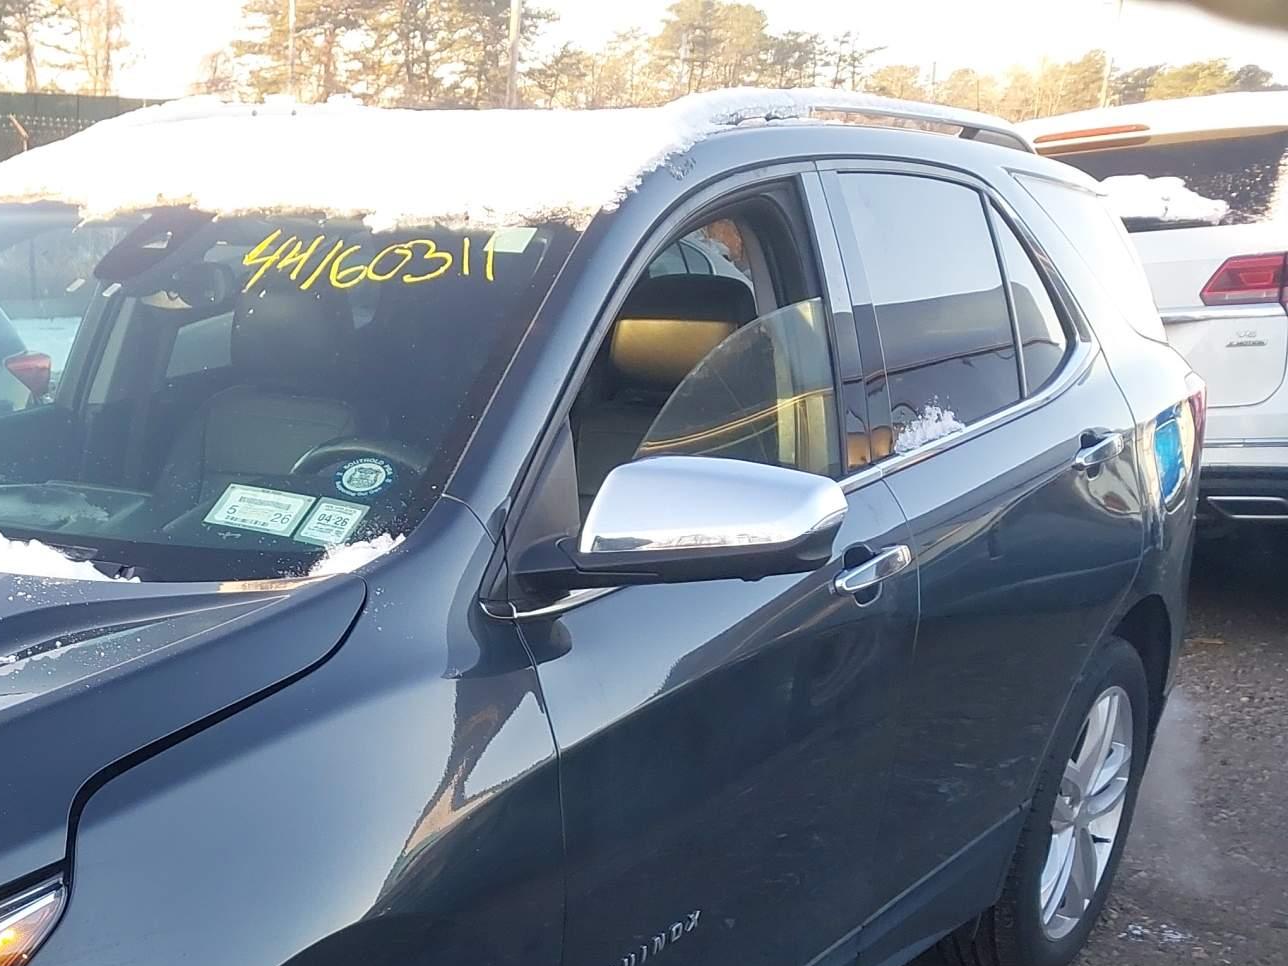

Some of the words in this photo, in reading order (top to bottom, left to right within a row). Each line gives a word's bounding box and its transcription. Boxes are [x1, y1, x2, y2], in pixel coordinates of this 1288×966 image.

[242, 229, 495, 293] 44160311
[226, 505, 240, 515] 5
[270, 512, 292, 525] 26
